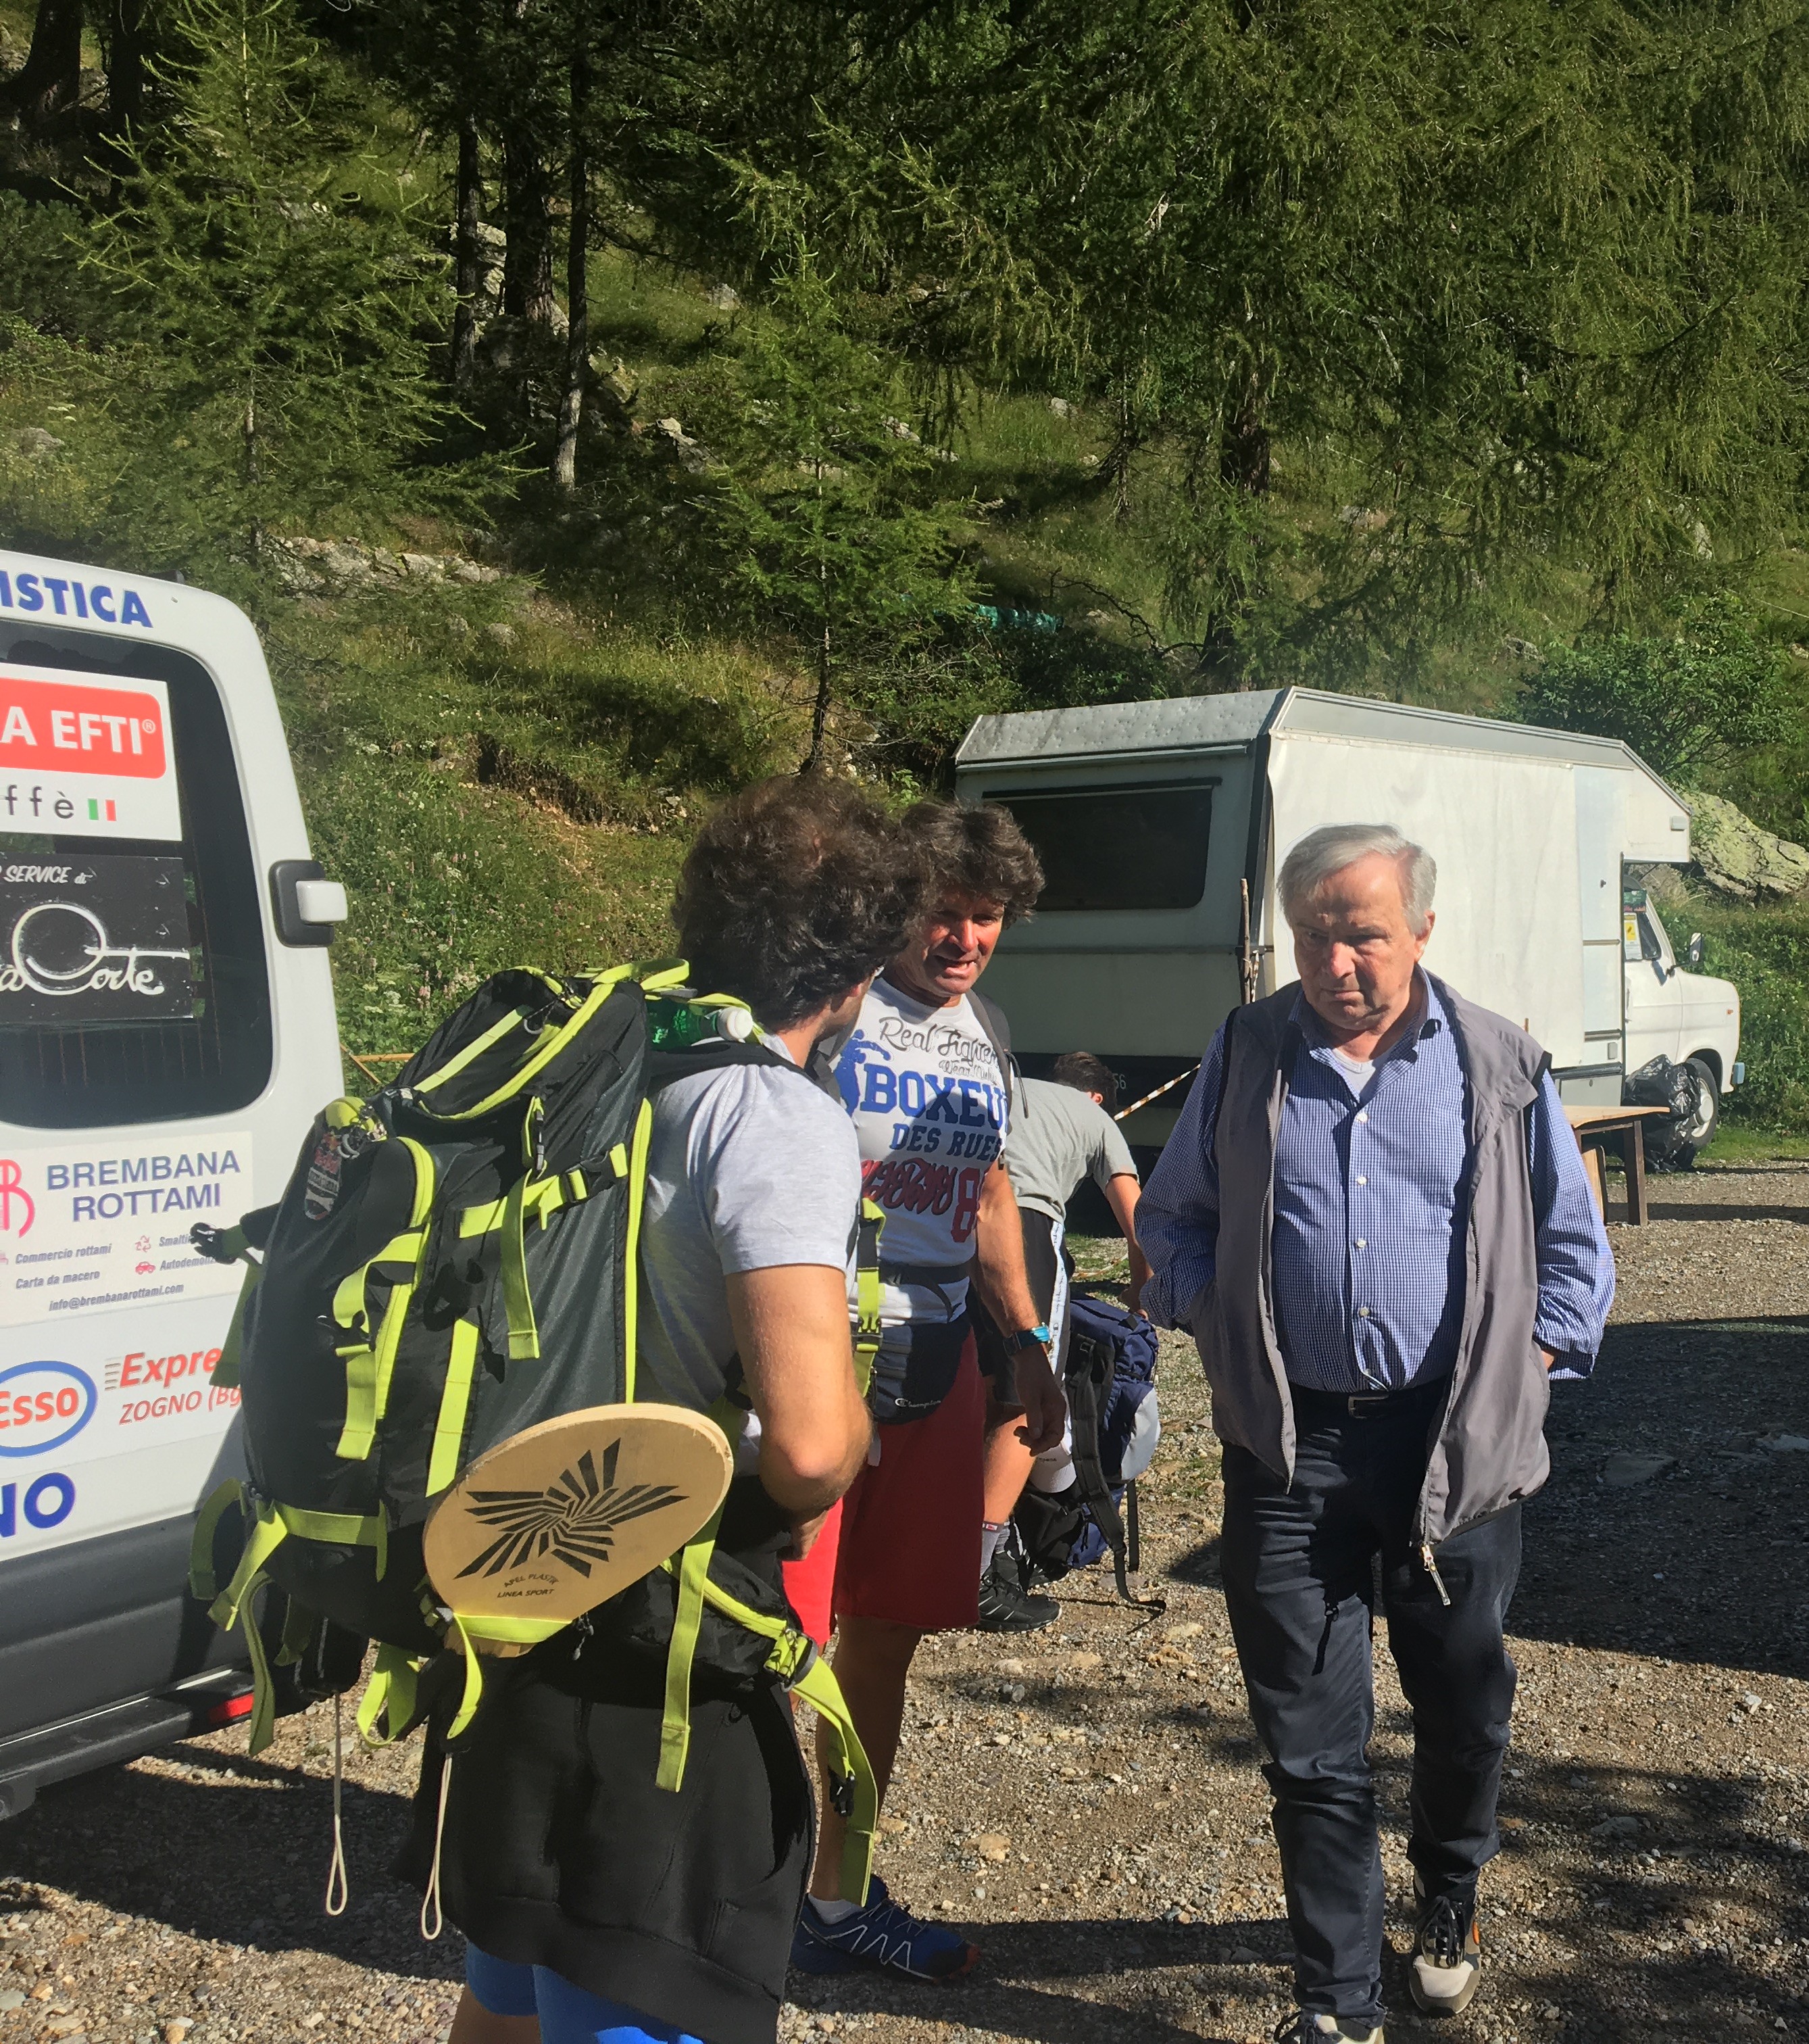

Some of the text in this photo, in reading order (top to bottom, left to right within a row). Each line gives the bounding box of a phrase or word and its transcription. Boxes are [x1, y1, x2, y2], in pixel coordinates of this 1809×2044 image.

[1, 706, 37, 746] A
[3, 865, 72, 883] SERVICE
[879, 1016, 938, 1053] Real
[889, 1122, 941, 1153] DES
[47, 1150, 241, 1190] BREMBANA
[72, 1182, 221, 1223] ROTTAMI
[15, 1243, 112, 1265] Commercio rottami
[158, 1234, 193, 1247] Smalti
[16, 1270, 101, 1290] Carta da macero
[49, 1284, 184, 1311] info@brembanarottami.com
[118, 1390, 203, 1426] ZOGNO
[497, 1588, 555, 1599] LINEA SPORT
